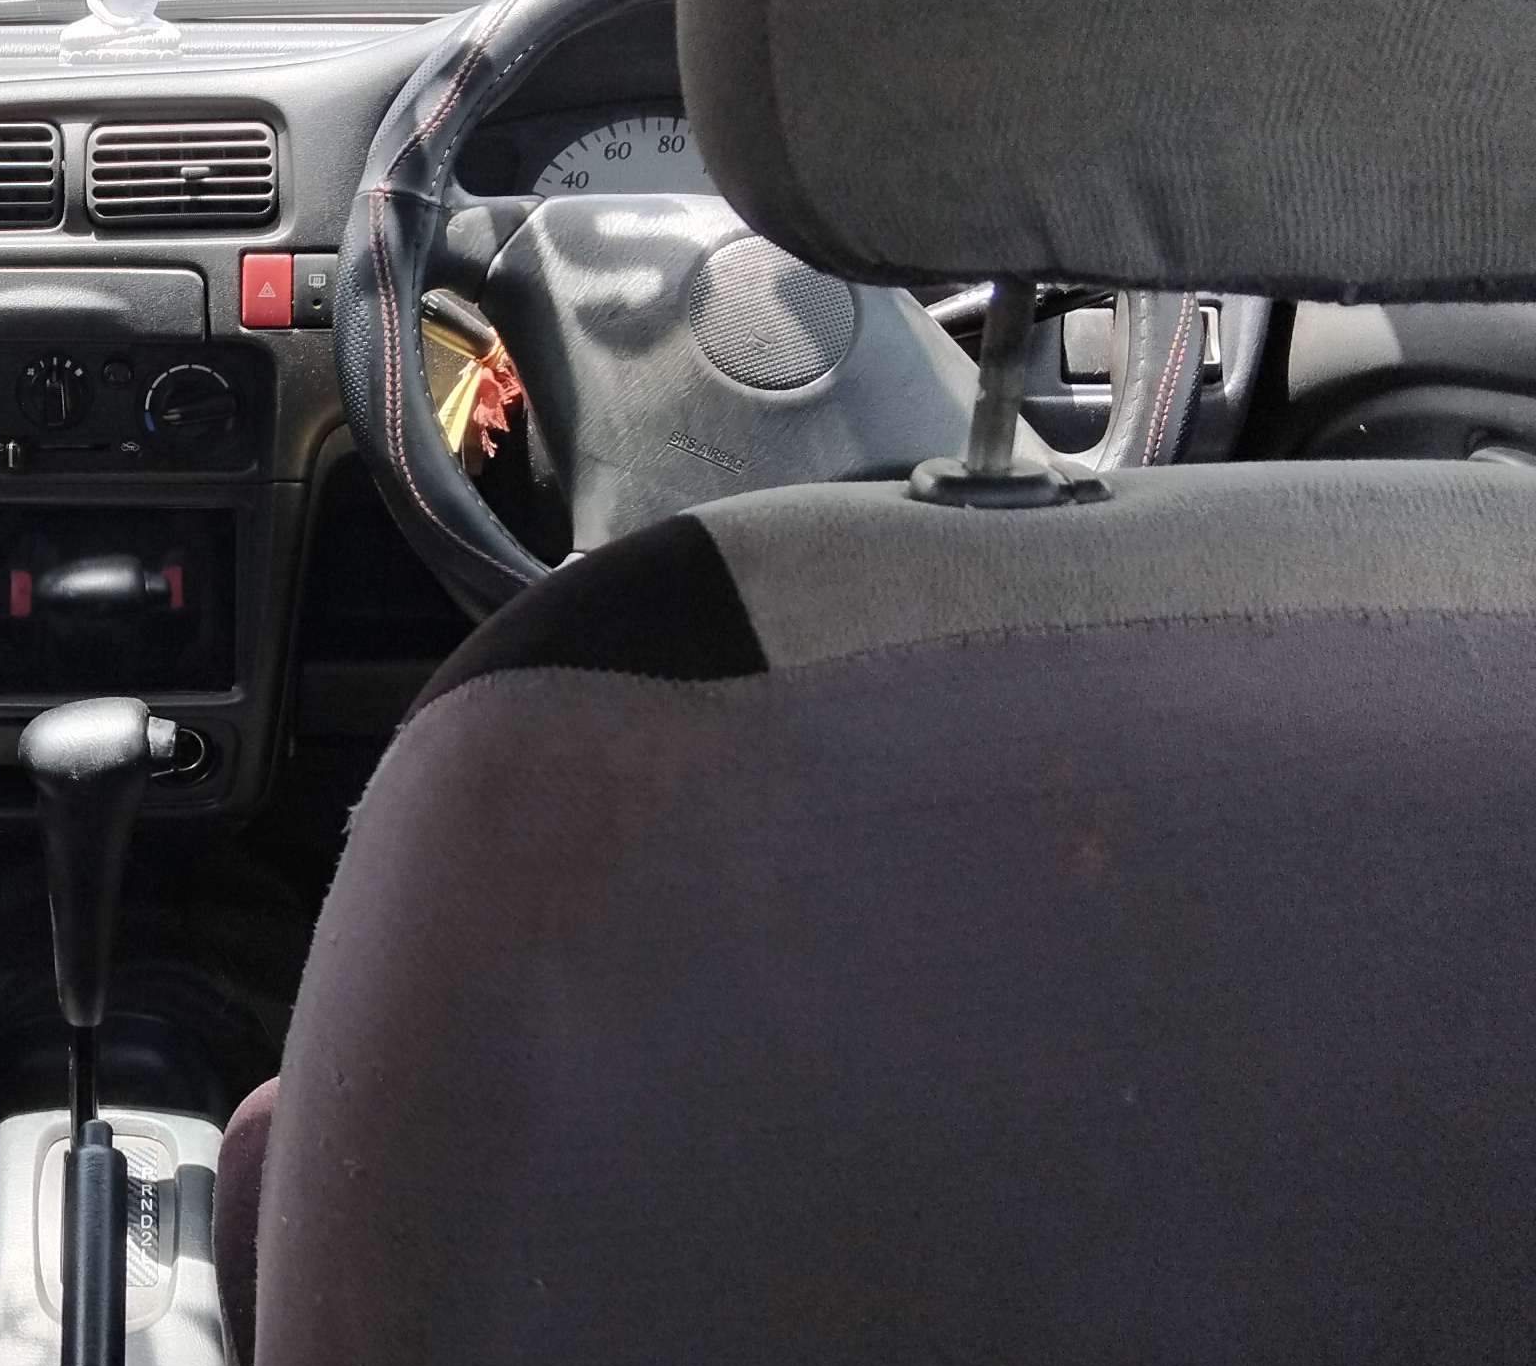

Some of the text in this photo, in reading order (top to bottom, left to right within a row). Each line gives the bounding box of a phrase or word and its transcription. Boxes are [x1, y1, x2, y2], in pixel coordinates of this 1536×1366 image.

[603, 141, 632, 161] 60
[657, 134, 686, 154] 80
[560, 170, 590, 190] 40
[669, 430, 745, 471] SRS AIRBAG
[141, 1184, 154, 1197] R
[140, 1198, 154, 1212] N
[140, 1214, 154, 1228] D
[140, 1231, 153, 1246] 2
